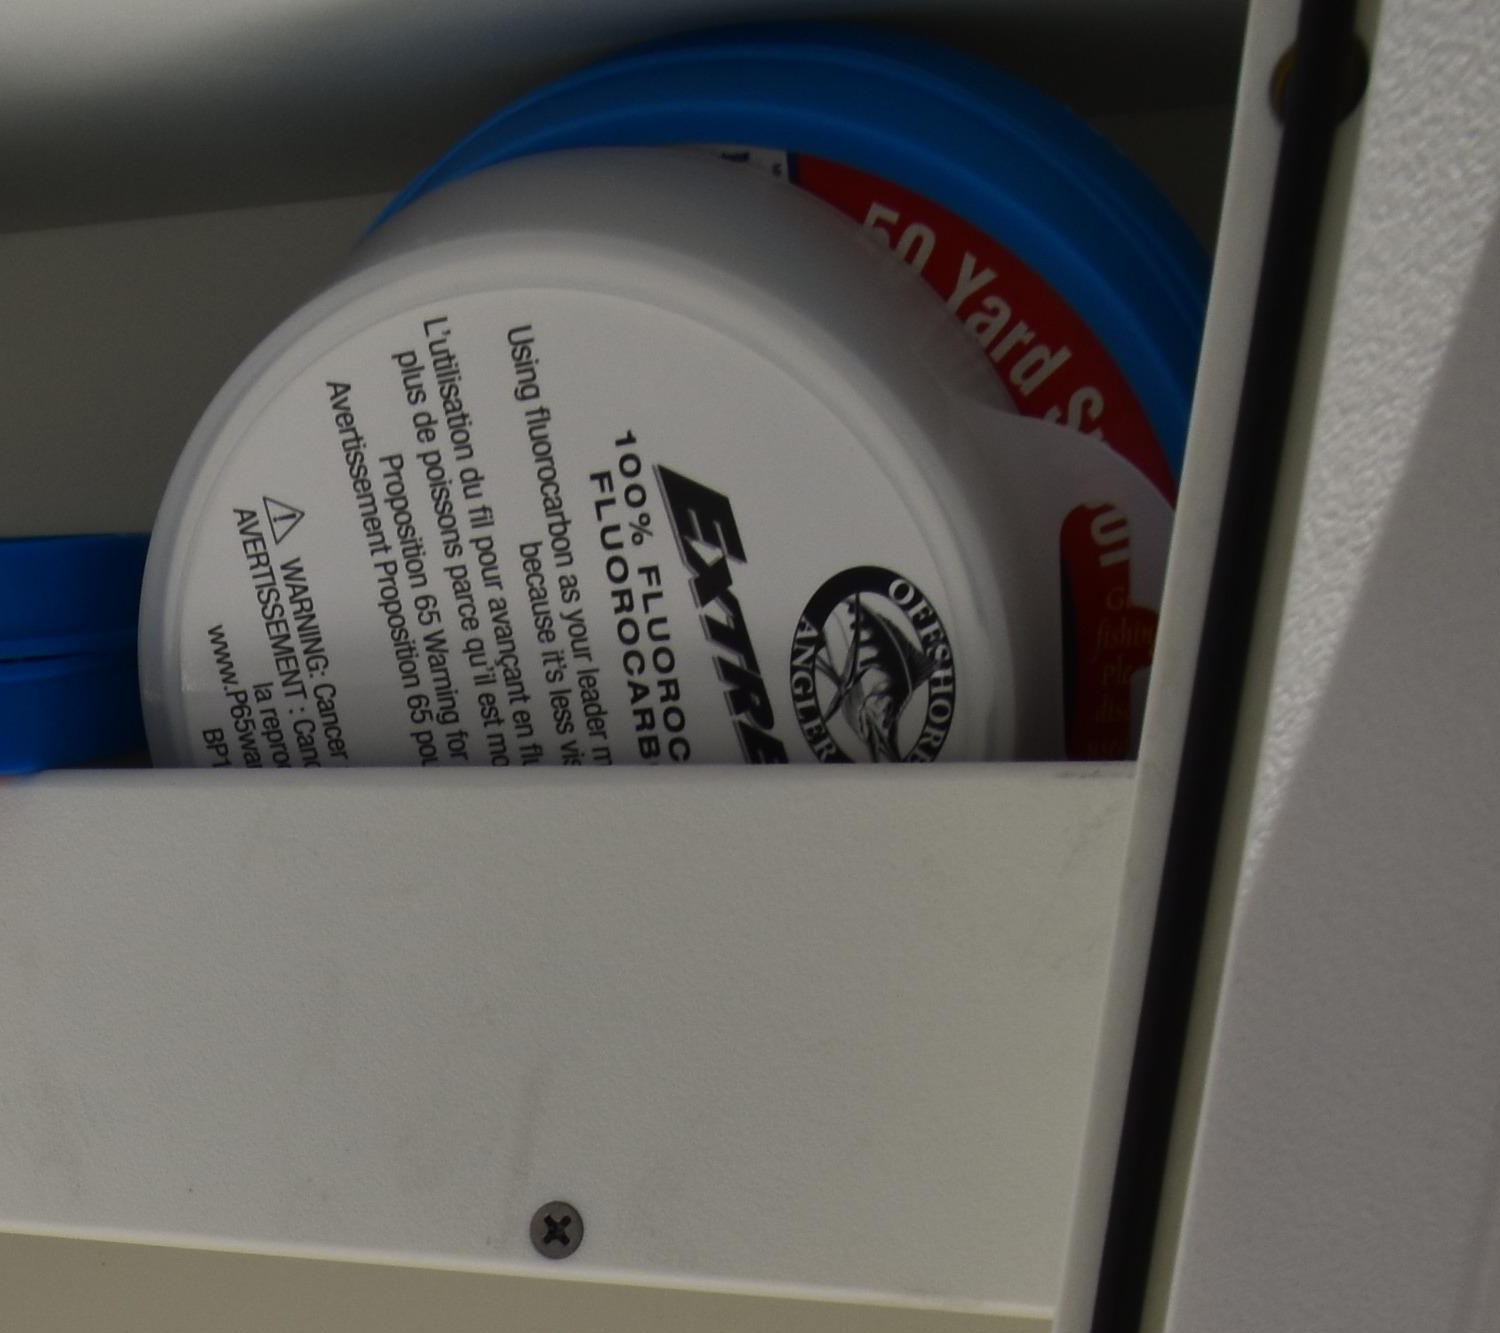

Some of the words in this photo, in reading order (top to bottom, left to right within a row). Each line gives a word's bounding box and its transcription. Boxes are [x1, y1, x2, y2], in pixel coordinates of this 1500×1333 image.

[946, 250, 1073, 399] Yard
[392, 351, 426, 405] plus
[424, 317, 473, 460] L'utilisation
[508, 325, 540, 401] Using
[413, 412, 438, 443] de
[417, 450, 463, 558] poissons
[460, 468, 484, 499] du
[526, 406, 573, 567] fluorocarbon
[616, 431, 652, 545] 100%
[380, 454, 427, 588] Proposition
[469, 505, 494, 528] fil
[327, 382, 391, 556] Avertissement
[374, 560, 420, 688] Proposition
[407, 694, 433, 724] 65
[469, 536, 503, 590] pour
[234, 509, 307, 699] AVERTISSEMENT
[414, 595, 441, 625] 65
[444, 565, 479, 631] parce
[520, 542, 556, 643] because
[559, 575, 580, 603] as
[281, 558, 328, 677] WARNING:
[313, 684, 348, 765] Cancer
[462, 638, 497, 686] qu'il
[488, 598, 530, 704] avançant
[560, 609, 592, 661] your
[253, 682, 273, 703] la
[423, 629, 459, 725] Warning
[542, 650, 567, 683] it's
[478, 693, 504, 727] est
[512, 710, 533, 738] en
[550, 689, 574, 734] less
[577, 669, 607, 739] leader
[446, 730, 470, 765] for
